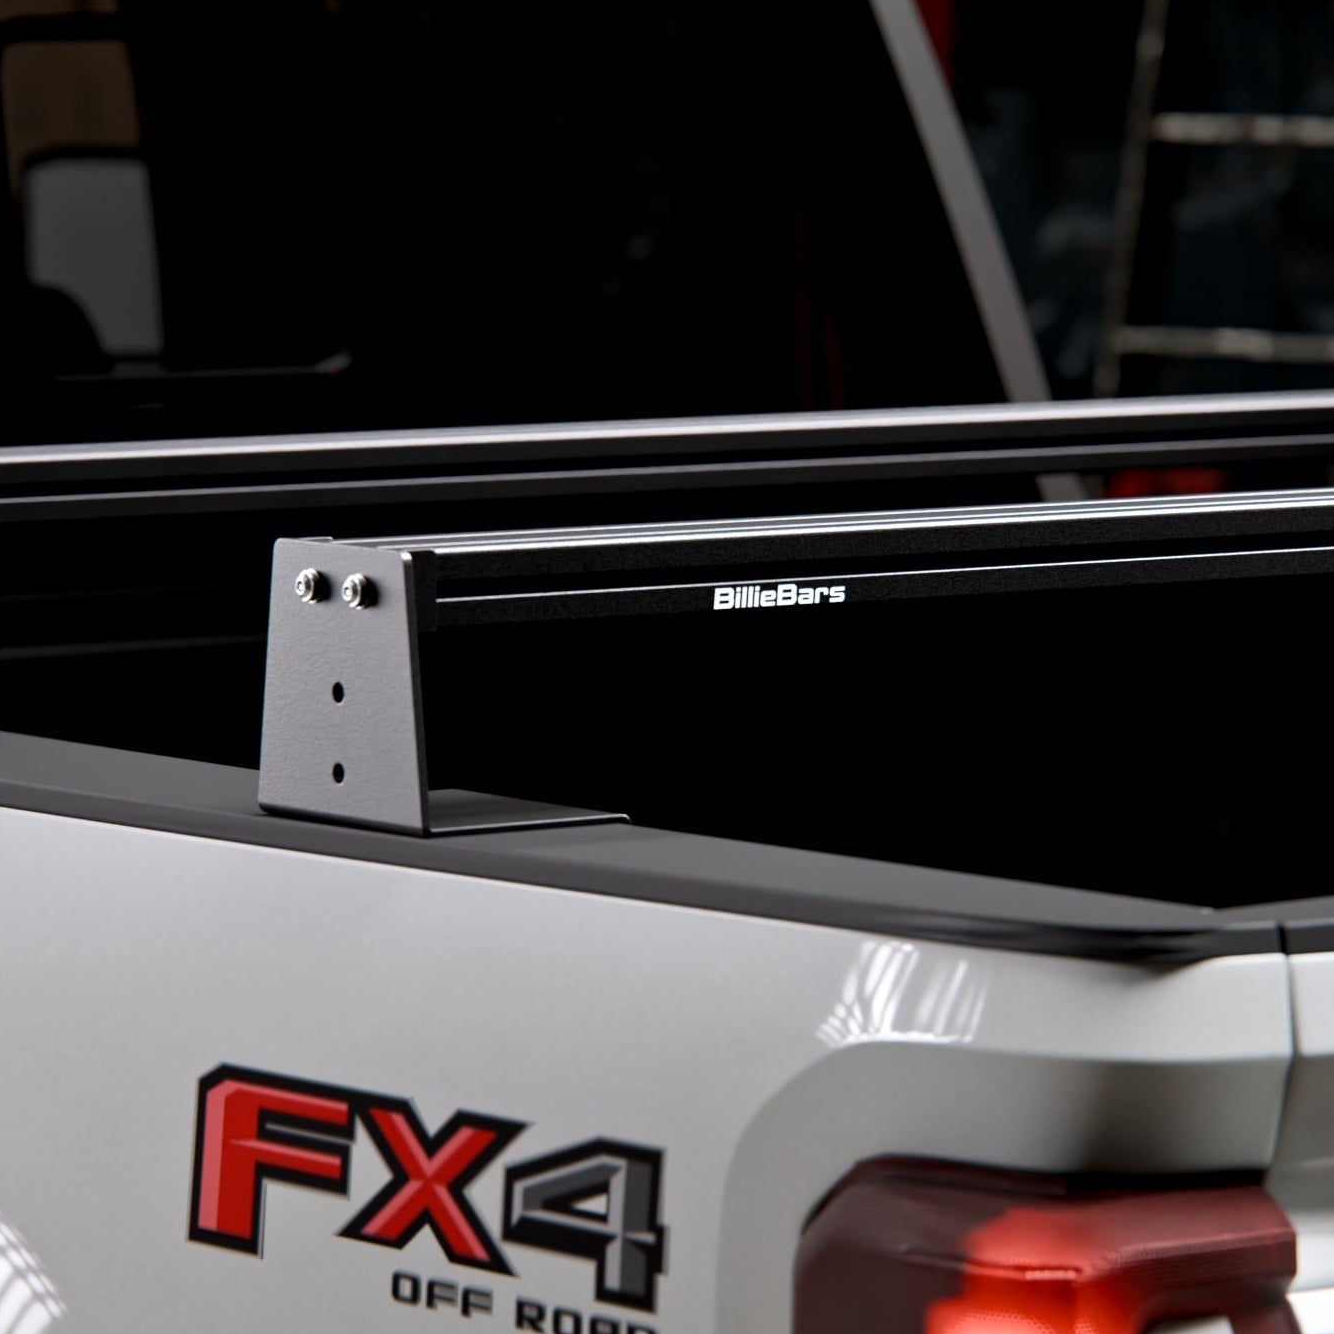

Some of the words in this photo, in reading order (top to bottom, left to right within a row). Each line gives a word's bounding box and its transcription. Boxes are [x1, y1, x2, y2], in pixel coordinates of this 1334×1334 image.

[713, 583, 846, 610] BillieBars
[188, 1062, 670, 1315] FX4
[391, 1270, 493, 1318] OFF
